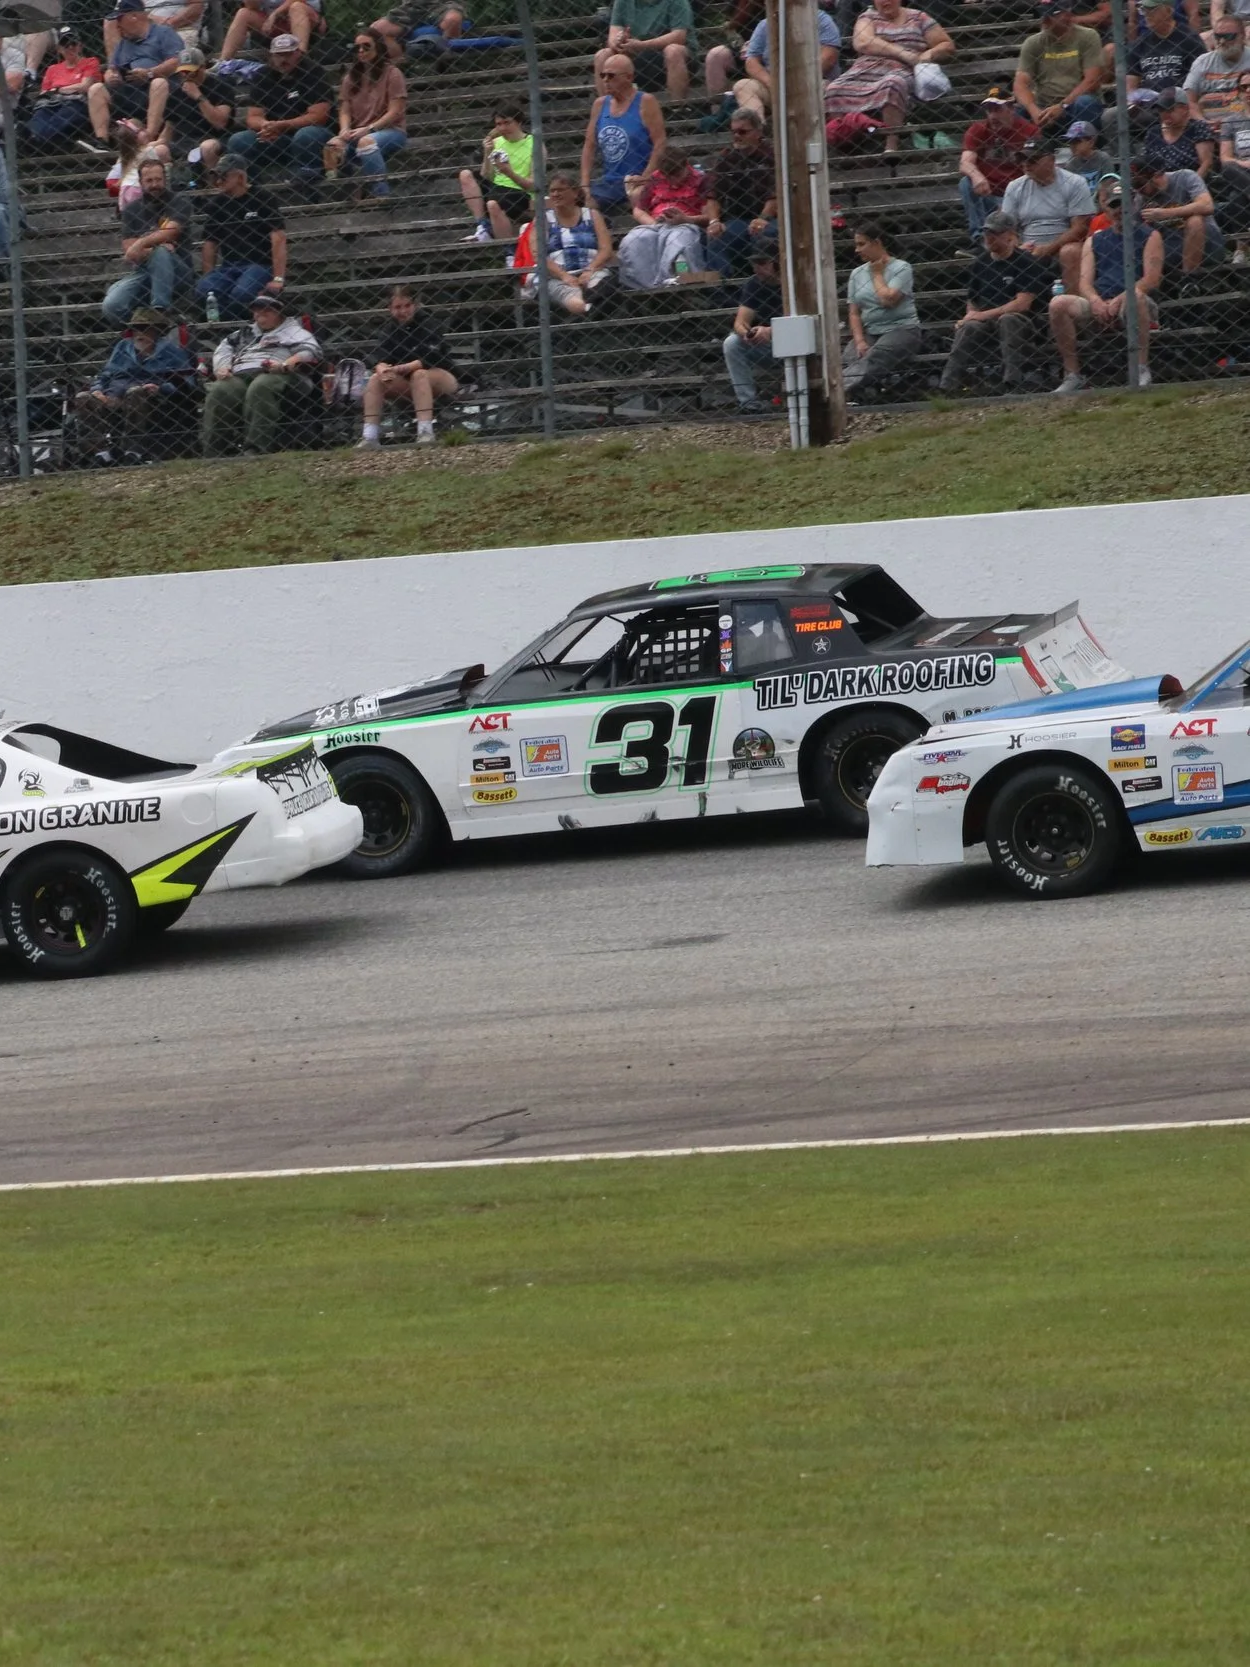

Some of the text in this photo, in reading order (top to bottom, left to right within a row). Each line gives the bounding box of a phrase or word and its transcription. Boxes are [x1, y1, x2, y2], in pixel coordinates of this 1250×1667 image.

[795, 619, 842, 633] TIRE CLUB
[805, 665, 881, 704] DARK
[881, 653, 995, 695] ROOFING
[468, 712, 512, 734] ACT
[1170, 718, 1218, 738] ACT
[324, 728, 381, 749] Hoosier
[587, 694, 719, 796] 31
[1025, 731, 1077, 744] HOOSIER
[731, 758, 782, 771] MORE WILDLIFE
[1114, 760, 1139, 768] Milton
[477, 790, 513, 800] Bassett
[1054, 775, 1108, 829] Hoosier
[40, 797, 162, 831] GRANITE
[1149, 831, 1189, 842] Bassett
[997, 839, 1050, 892] Hoosier
[83, 867, 117, 931] Hoosier
[10, 902, 46, 964] Hoosier
